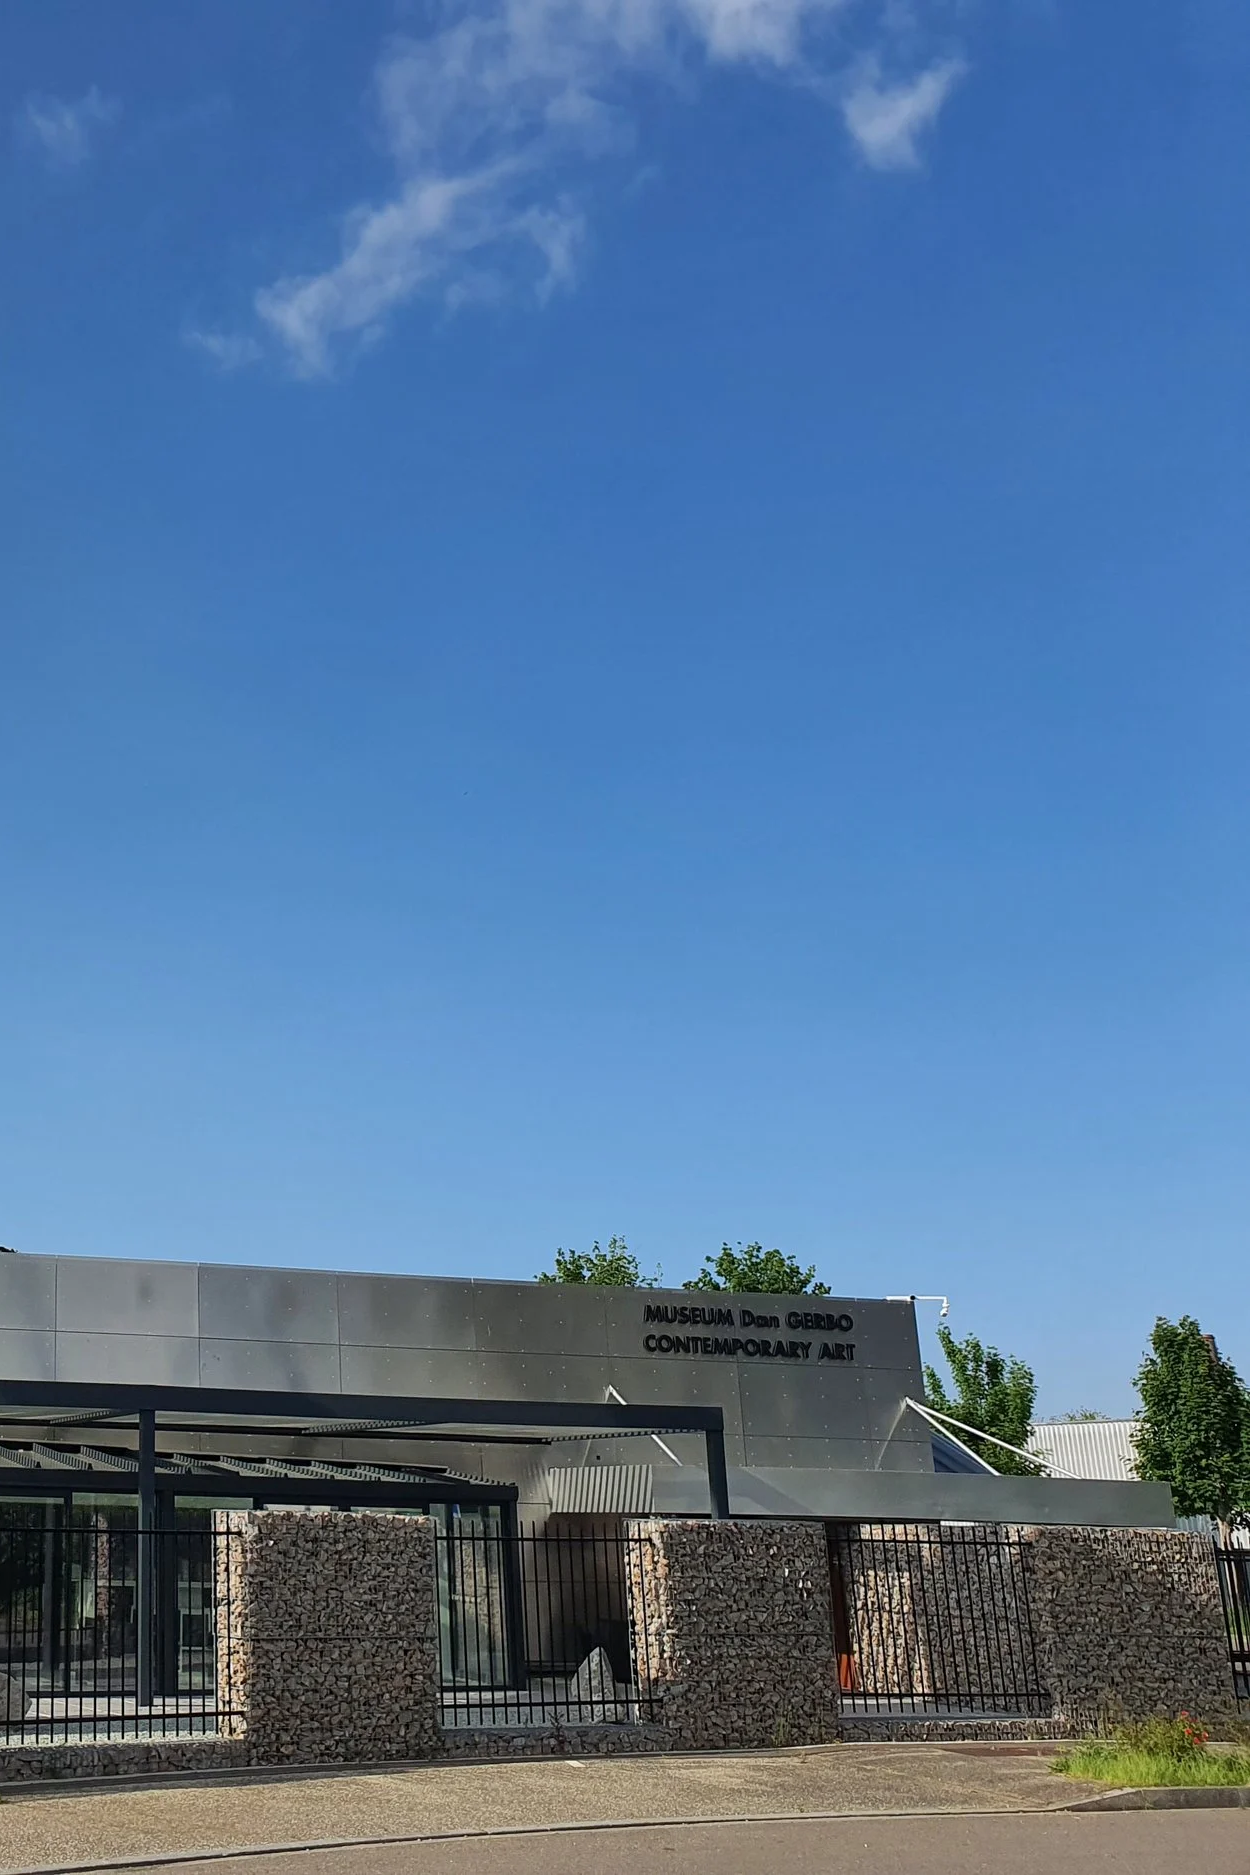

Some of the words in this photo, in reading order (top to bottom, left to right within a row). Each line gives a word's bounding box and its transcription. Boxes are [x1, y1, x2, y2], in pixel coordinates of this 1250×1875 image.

[644, 1305, 734, 1327] MUSEUM
[739, 1309, 780, 1329] Dan
[785, 1311, 854, 1332] GERBO
[643, 1334, 812, 1359] CONTEMPORARY
[818, 1342, 856, 1361] ART
